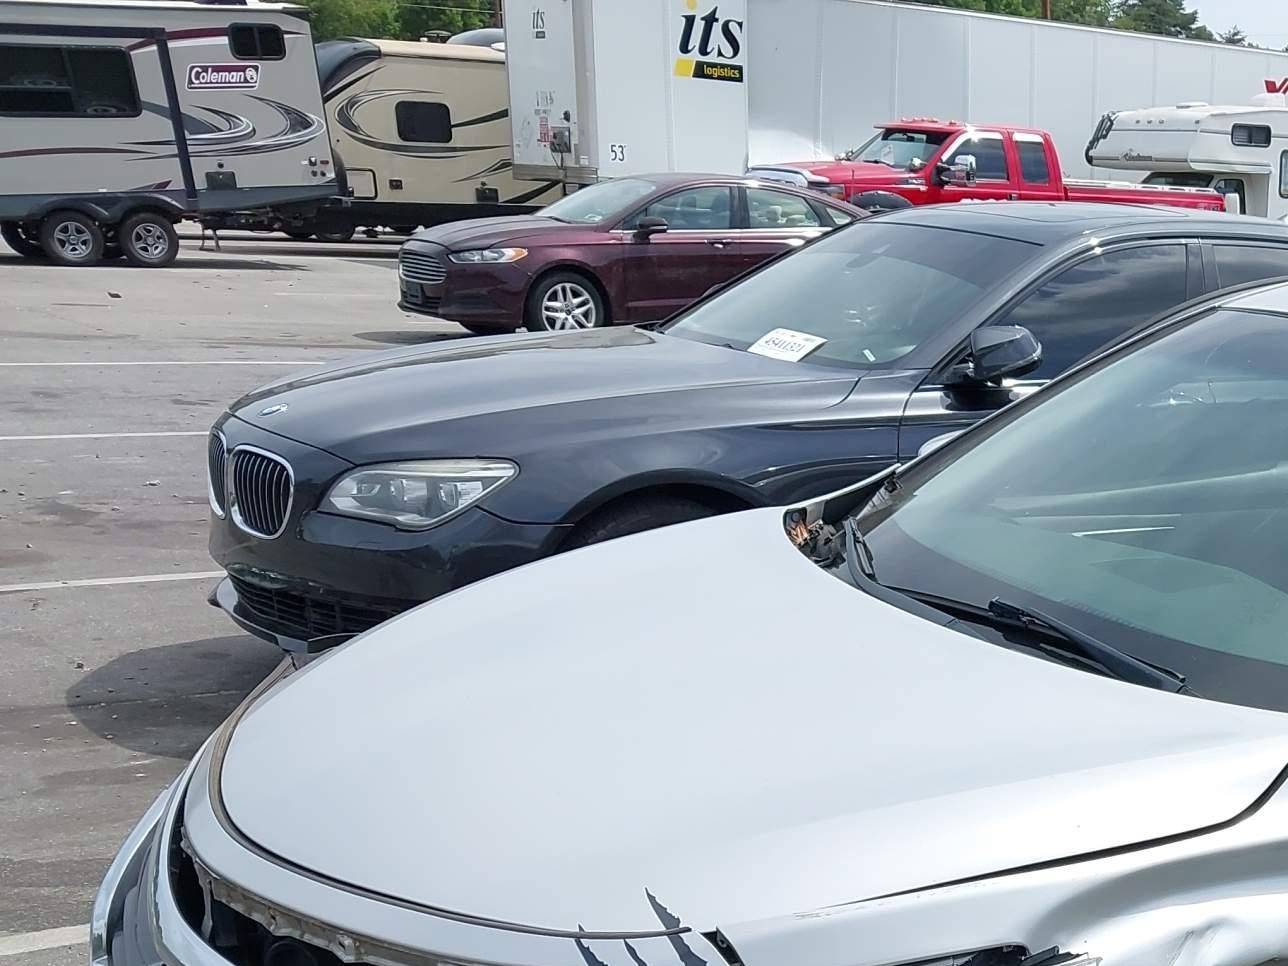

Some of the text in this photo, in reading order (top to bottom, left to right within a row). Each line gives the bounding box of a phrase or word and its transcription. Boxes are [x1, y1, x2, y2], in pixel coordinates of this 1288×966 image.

[679, 0, 743, 59] its
[191, 67, 244, 84] Coleman
[703, 65, 740, 78] logistics
